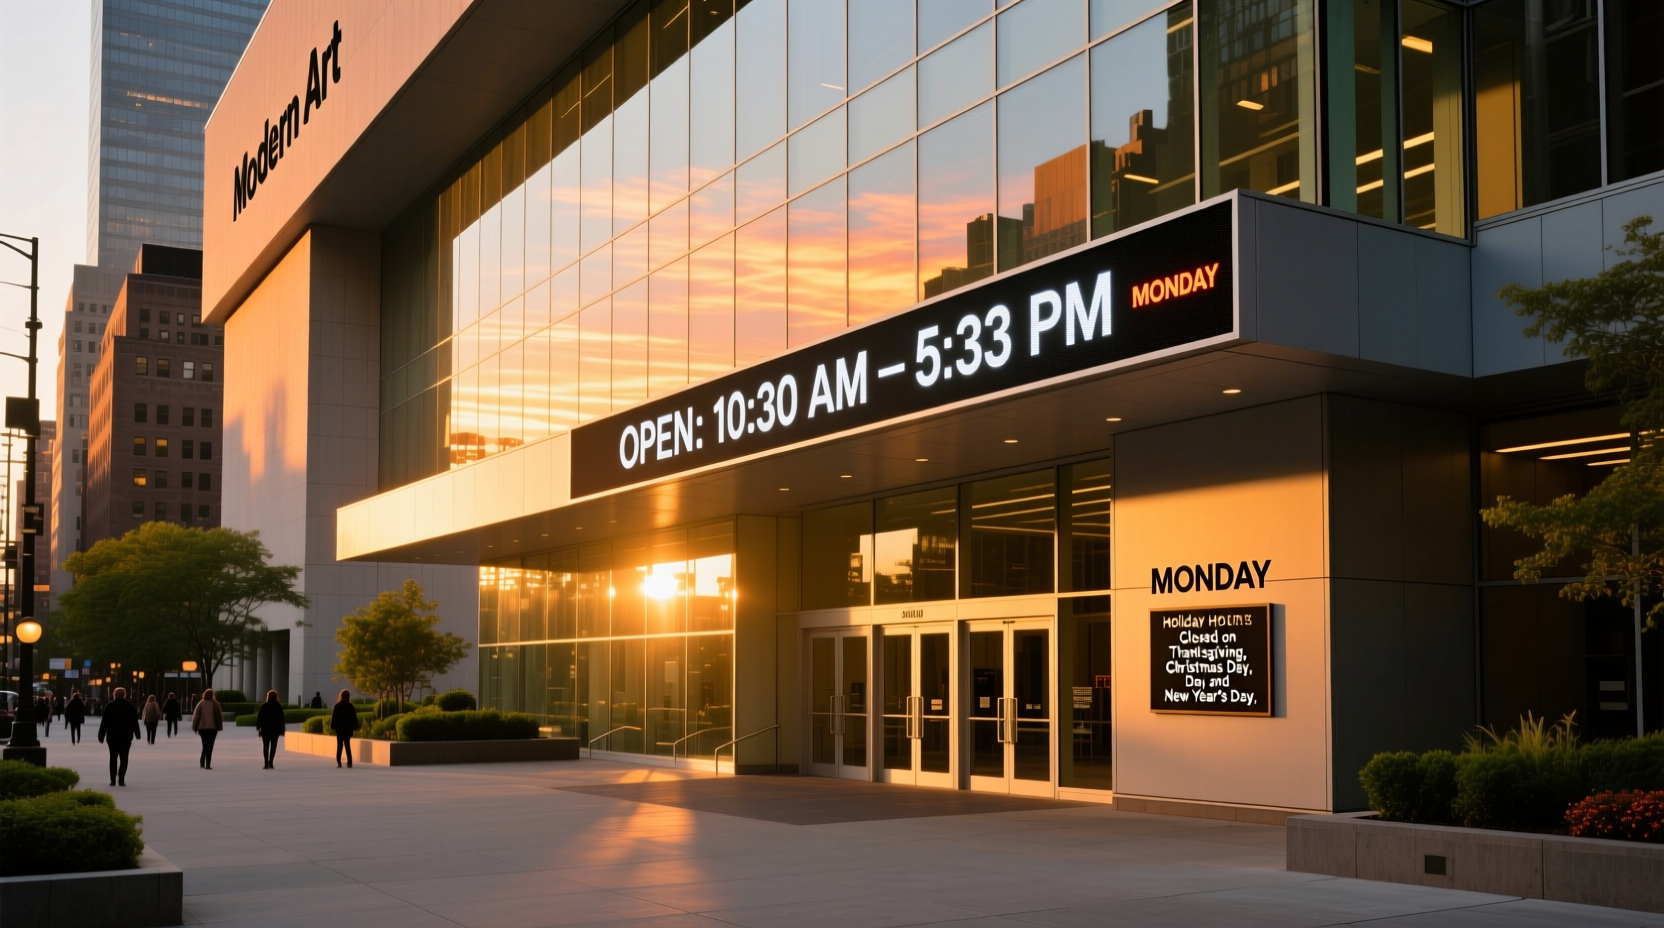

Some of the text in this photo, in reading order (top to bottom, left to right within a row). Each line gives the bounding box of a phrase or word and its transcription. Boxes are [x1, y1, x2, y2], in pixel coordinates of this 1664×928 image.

[233, 20, 343, 222] Modern Art
[1131, 262, 1219, 309] MONDAY
[619, 406, 703, 470] OPEN:
[713, 373, 798, 445] 10:30
[807, 350, 868, 419] AM
[915, 304, 1012, 387] 5:33
[1030, 270, 1113, 357] PM
[1151, 559, 1272, 595] MONDAY
[1221, 633, 1237, 643] on
[1164, 688, 1190, 703] New
[1209, 674, 1230, 688] and
